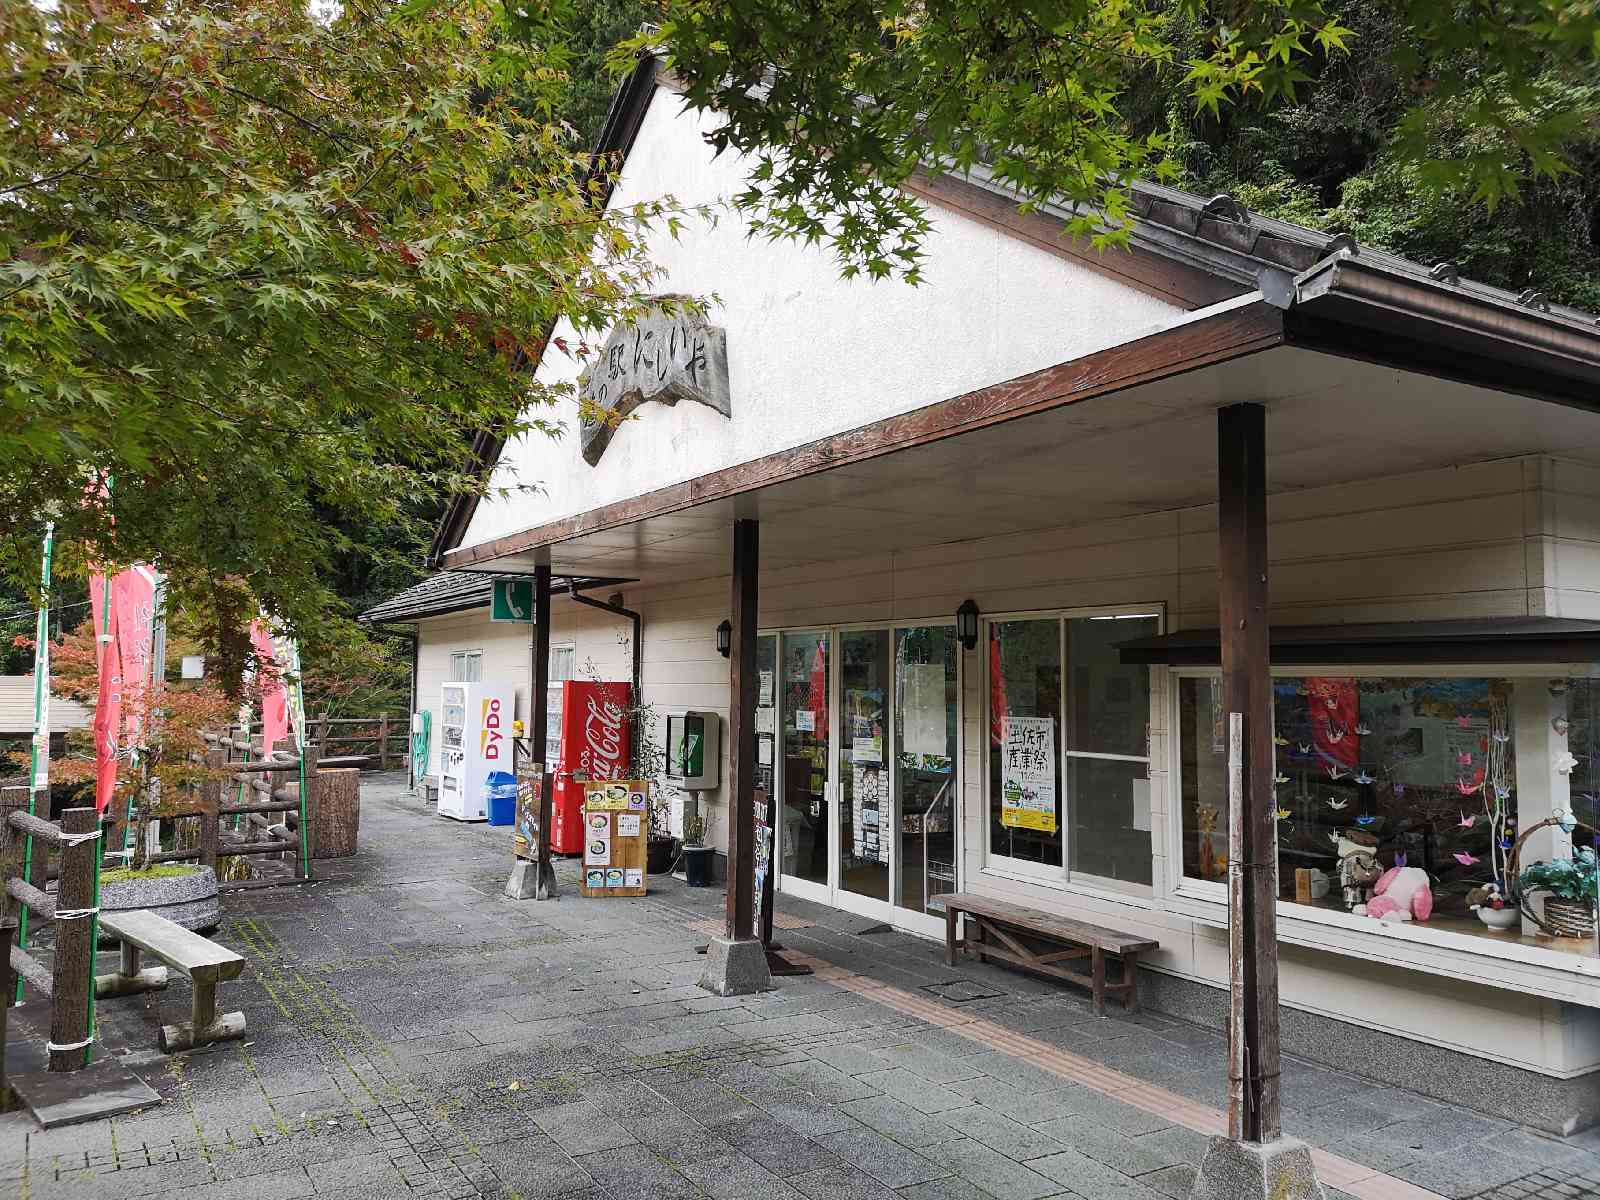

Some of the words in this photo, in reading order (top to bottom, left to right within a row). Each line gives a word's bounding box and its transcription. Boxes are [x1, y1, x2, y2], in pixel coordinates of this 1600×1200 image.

[485, 699, 504, 760] DyDo
[585, 695, 623, 782] ca-Cola
[1007, 745, 1048, 771] 産業祭
